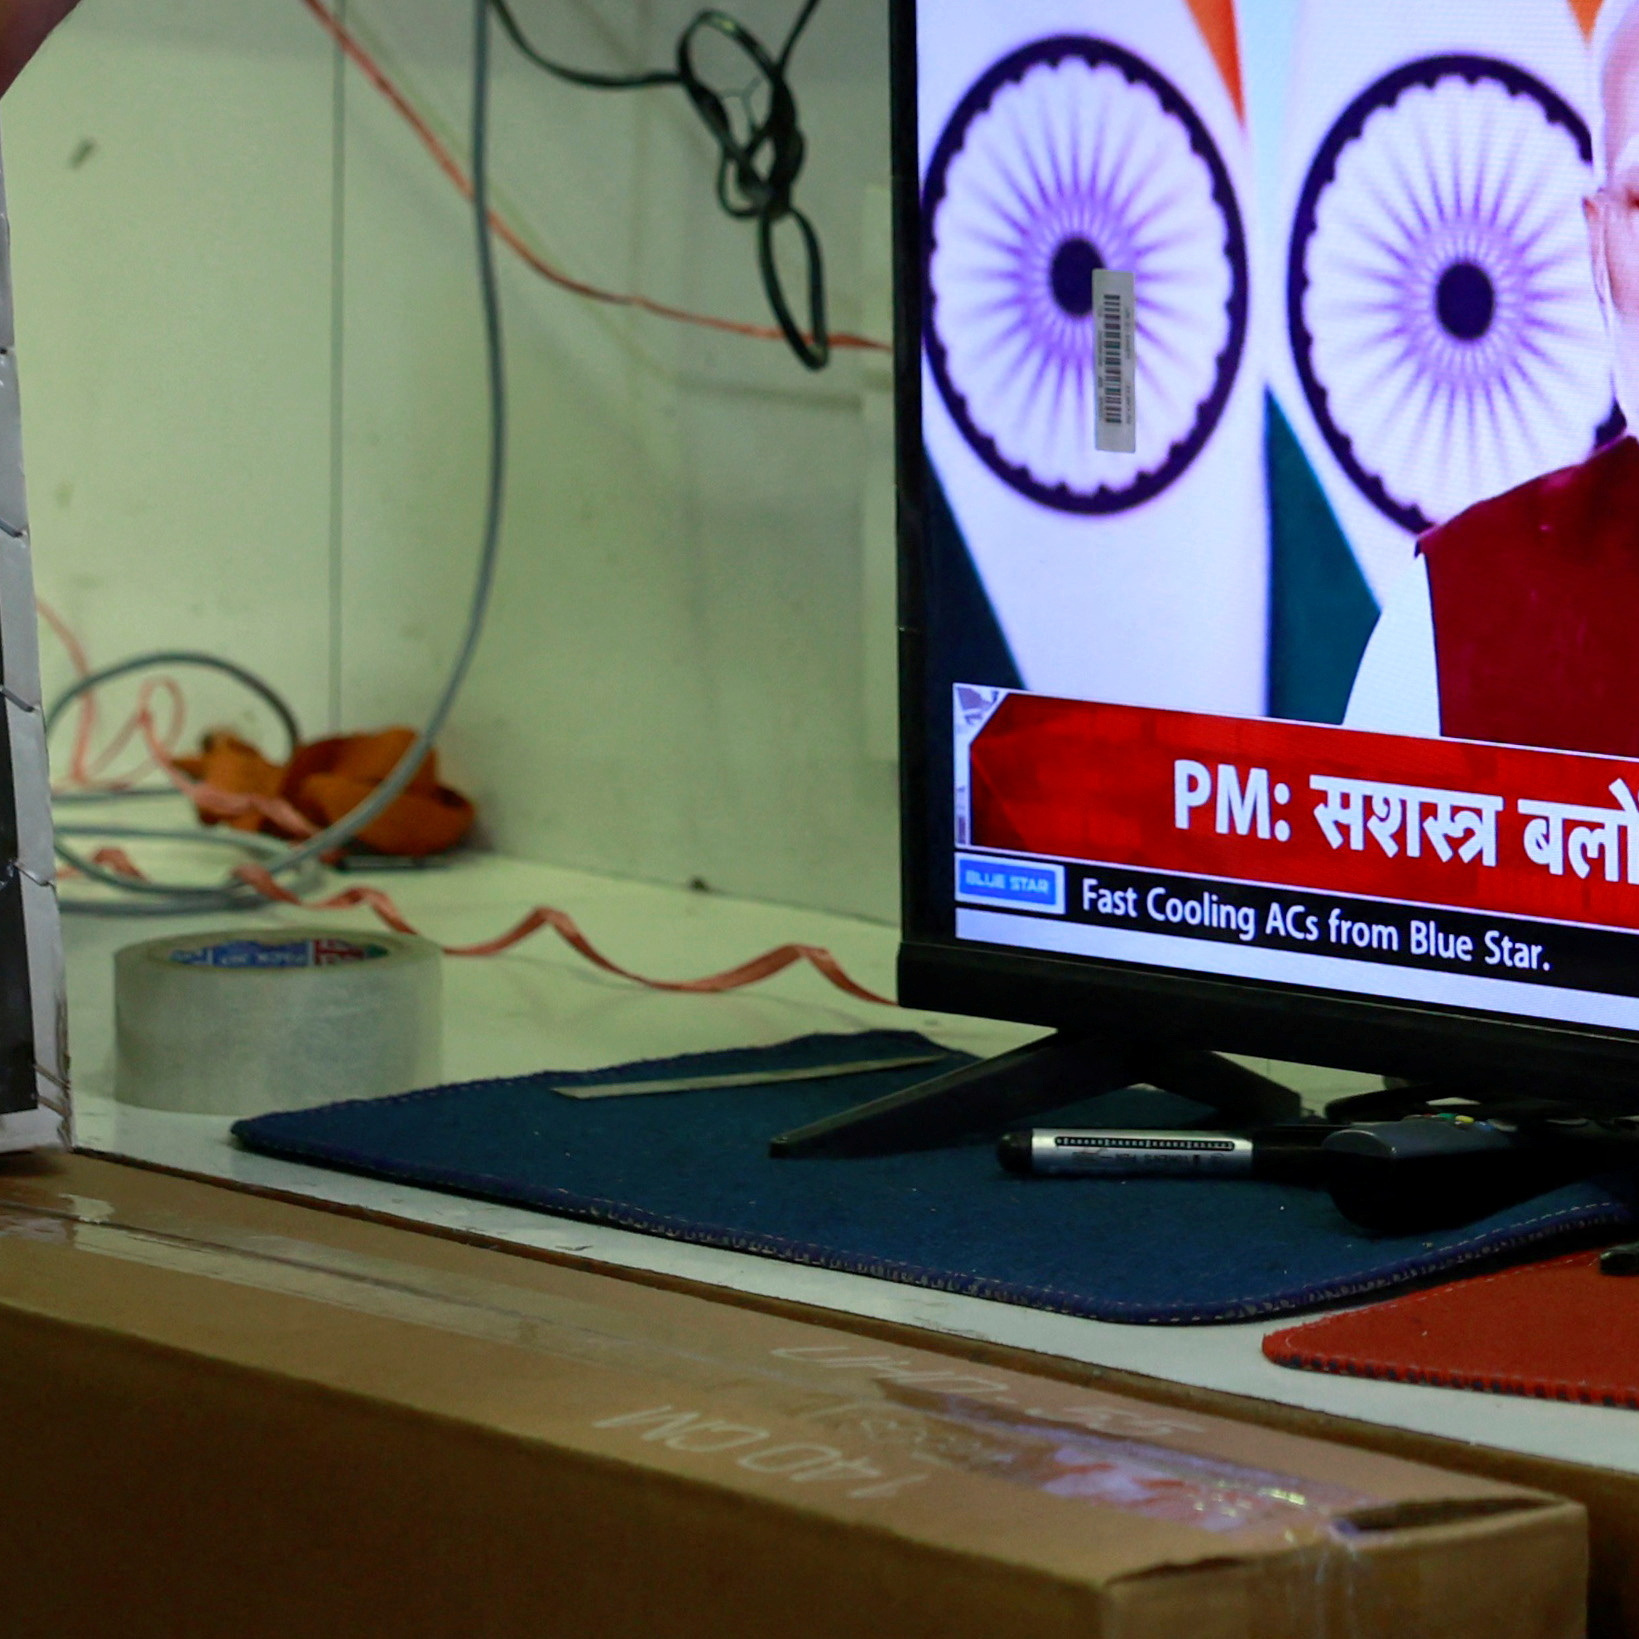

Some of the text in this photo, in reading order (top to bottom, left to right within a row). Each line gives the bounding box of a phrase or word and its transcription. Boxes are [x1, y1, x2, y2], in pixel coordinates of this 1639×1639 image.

[1173, 758, 1292, 842] PM:
[1309, 773, 1505, 868] सशस्त्र
[965, 869, 1050, 895] BLUE STAR
[1081, 876, 1552, 972] Fast Cooling ACs from Blue Star.
